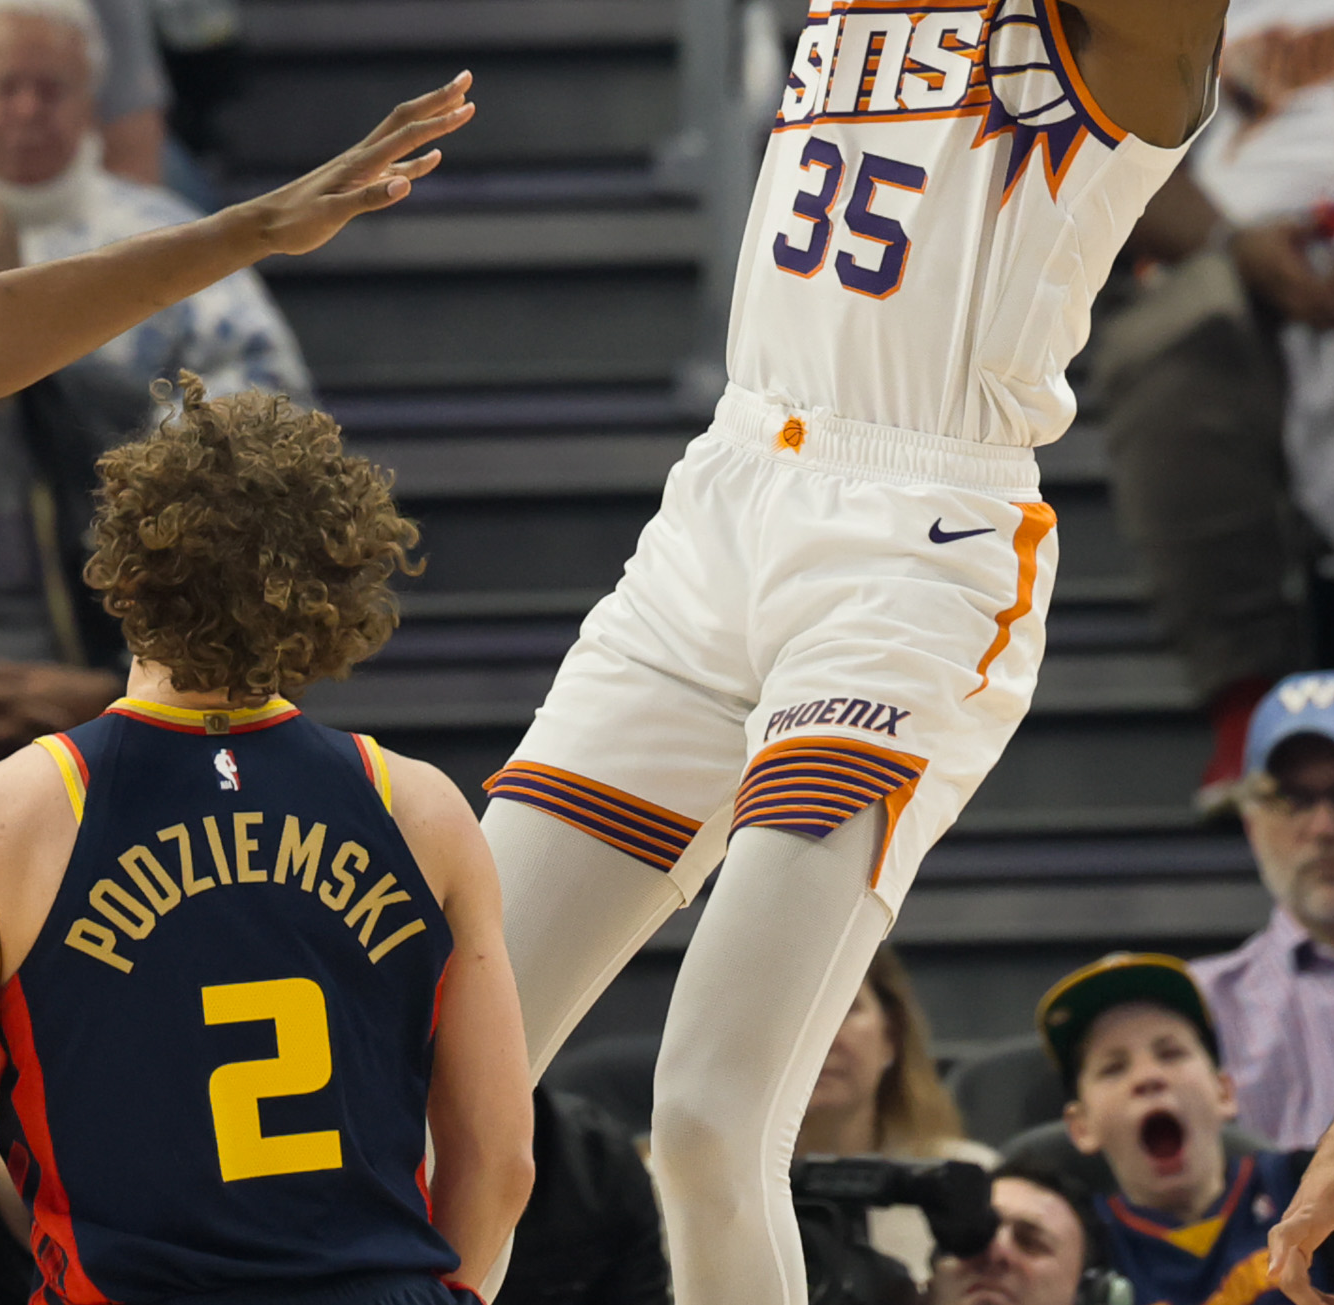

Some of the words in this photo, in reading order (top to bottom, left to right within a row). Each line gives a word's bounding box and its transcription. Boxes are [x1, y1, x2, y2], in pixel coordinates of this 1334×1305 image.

[773, 136, 928, 301] 35
[763, 696, 912, 742] PHOENIX
[64, 811, 427, 975] PODZIEMSKI
[200, 976, 344, 1183] 2
